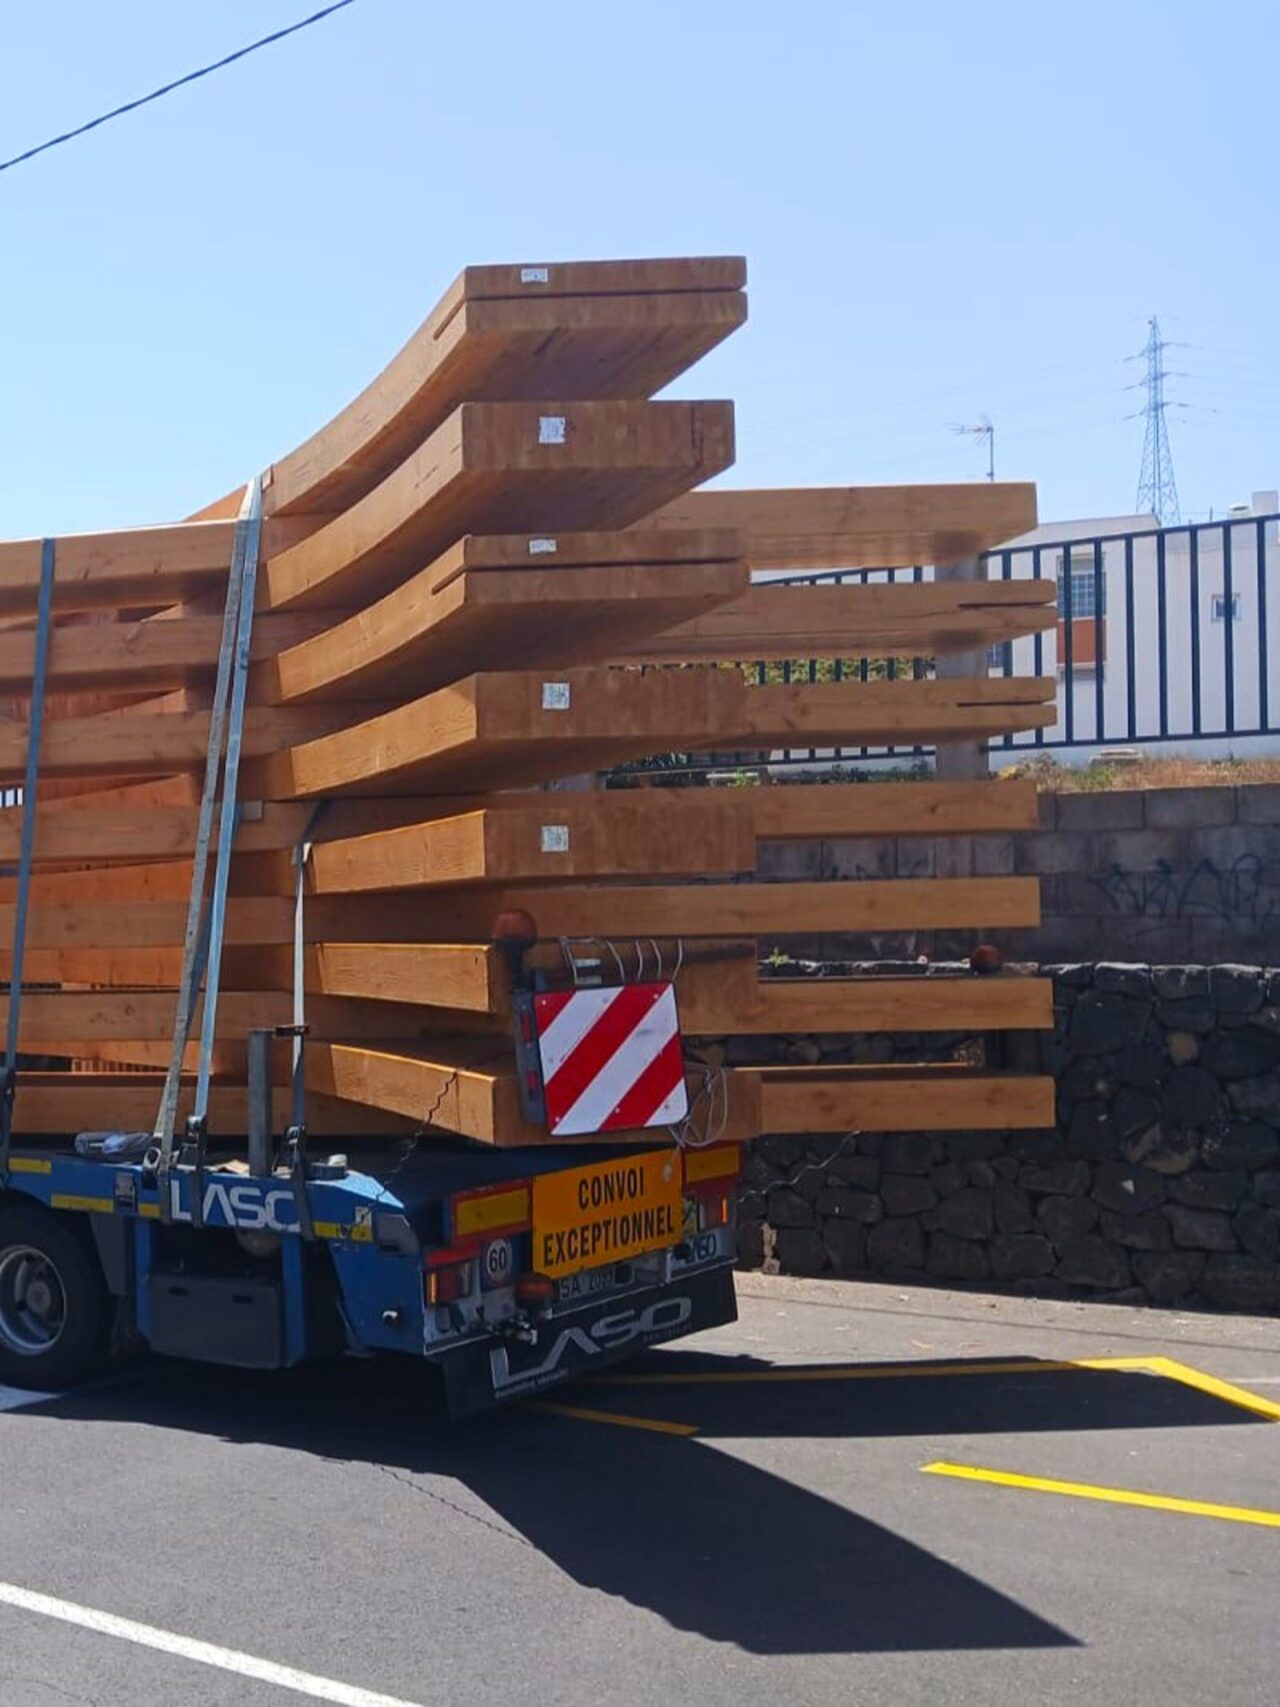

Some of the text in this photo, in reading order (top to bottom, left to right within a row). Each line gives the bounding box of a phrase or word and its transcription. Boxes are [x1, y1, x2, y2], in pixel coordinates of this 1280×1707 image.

[578, 1166, 644, 1210] CONVOI
[489, 1246, 507, 1273] 60
[544, 1204, 675, 1267] EXCEPTIONNEL
[489, 1297, 693, 1388] LASO
